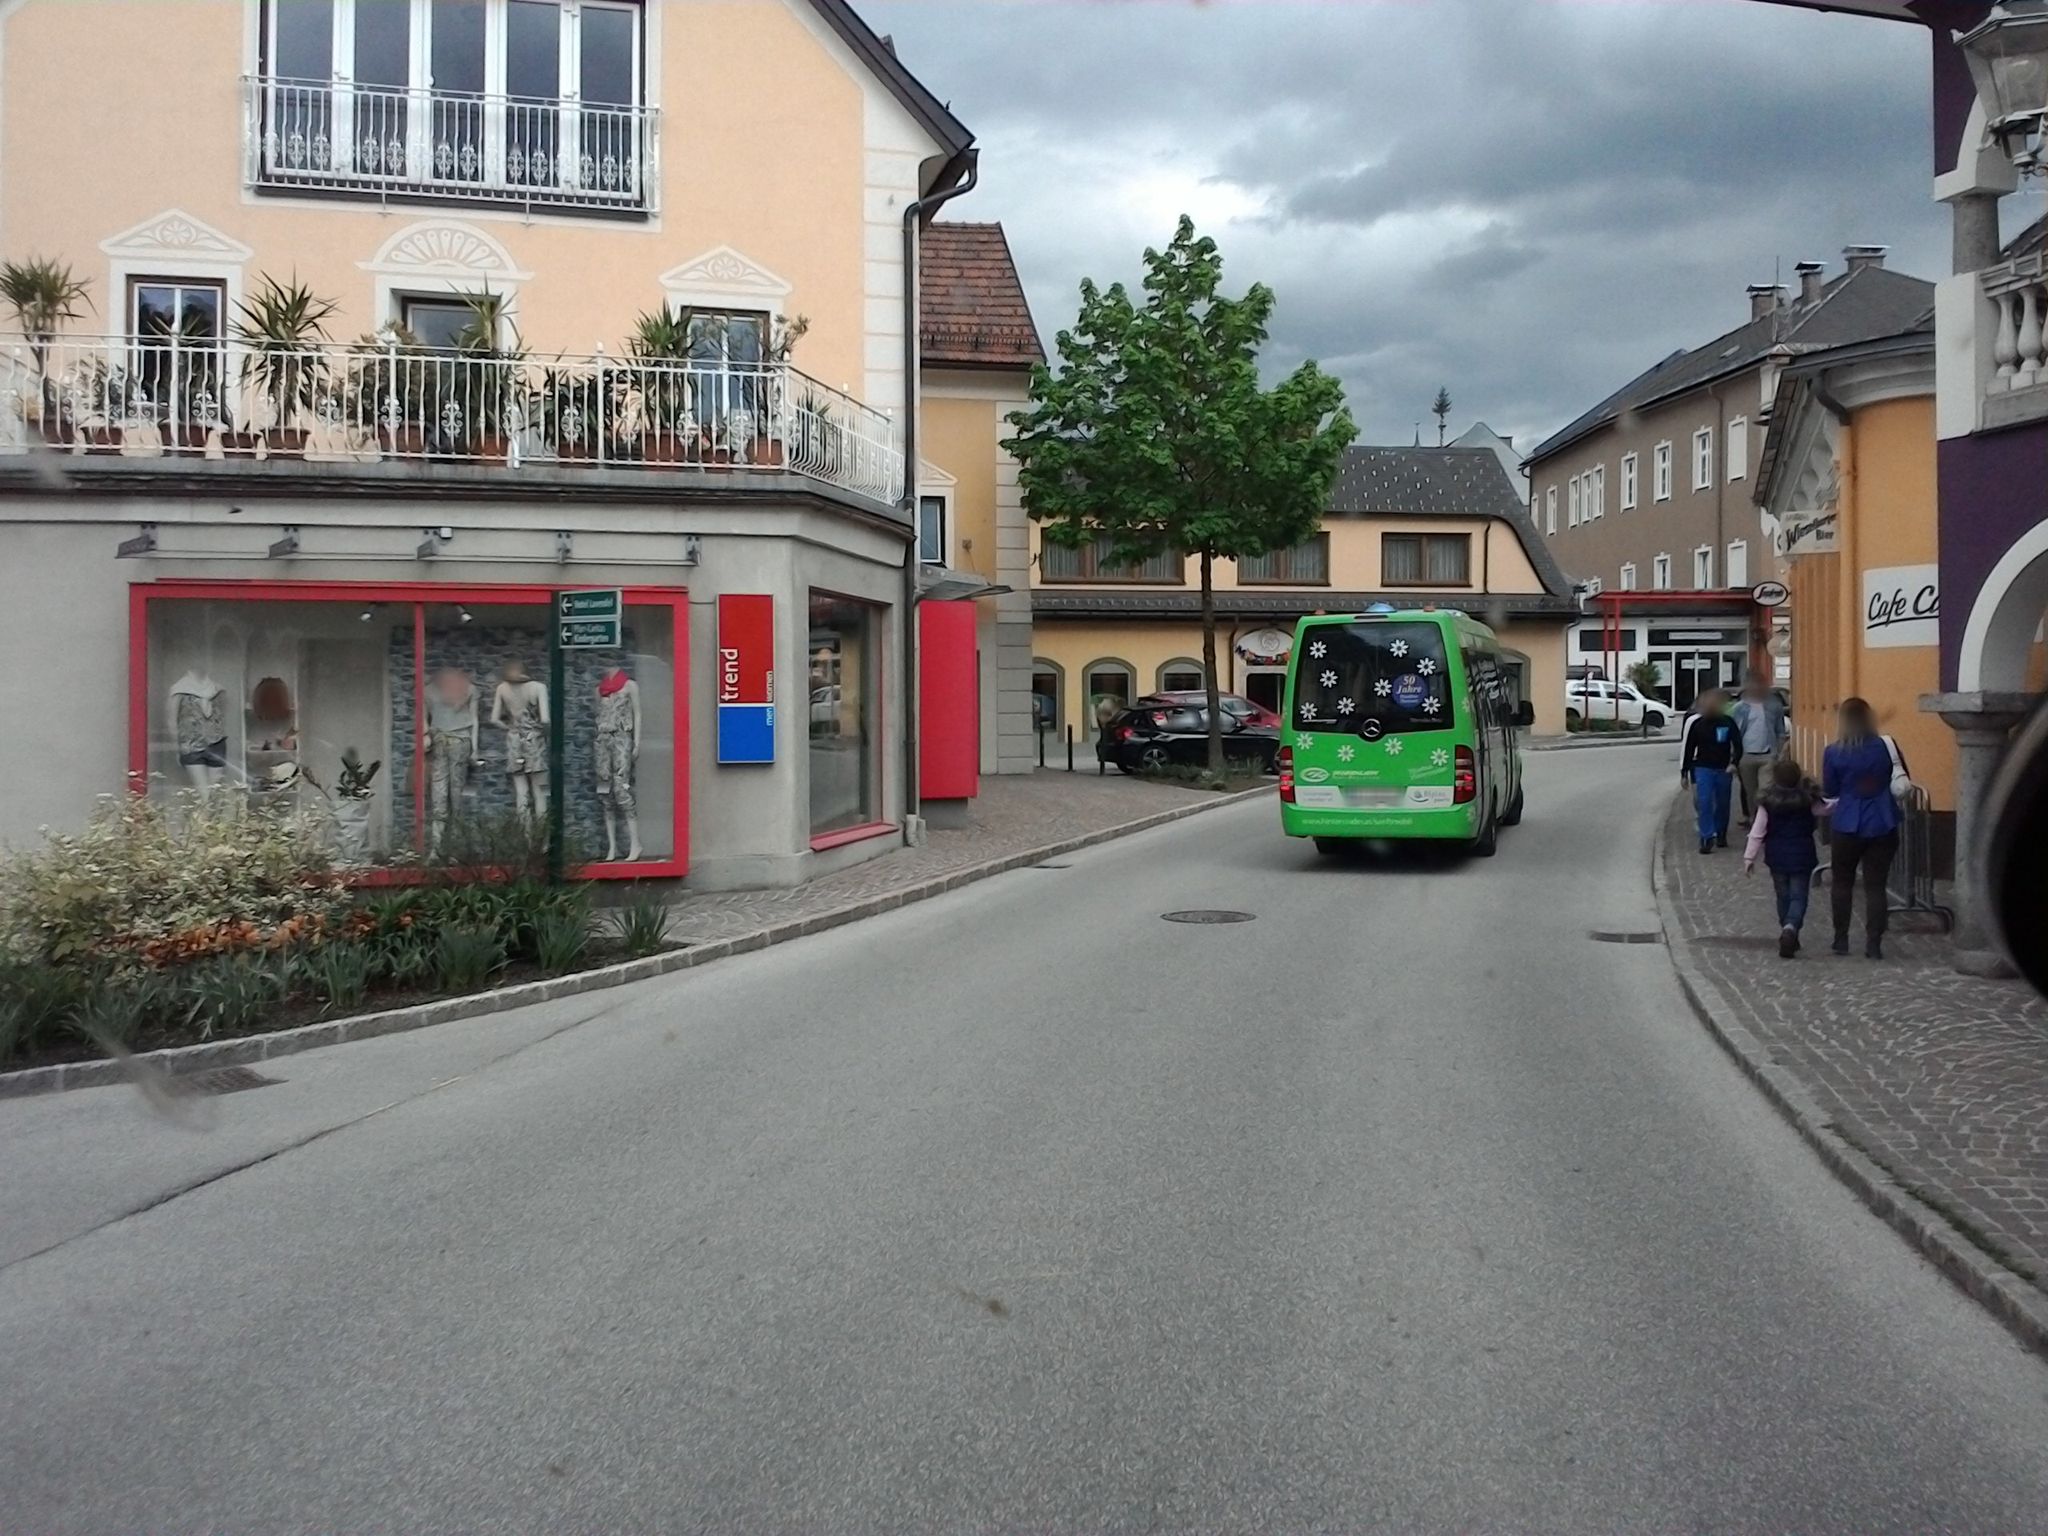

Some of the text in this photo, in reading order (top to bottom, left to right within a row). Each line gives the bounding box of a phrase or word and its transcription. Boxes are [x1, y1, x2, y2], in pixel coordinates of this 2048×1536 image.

[1868, 588, 1907, 627] Cafe
[720, 648, 739, 702] trend
[1402, 675, 1416, 685] 50
[1395, 685, 1422, 694] Jahre
